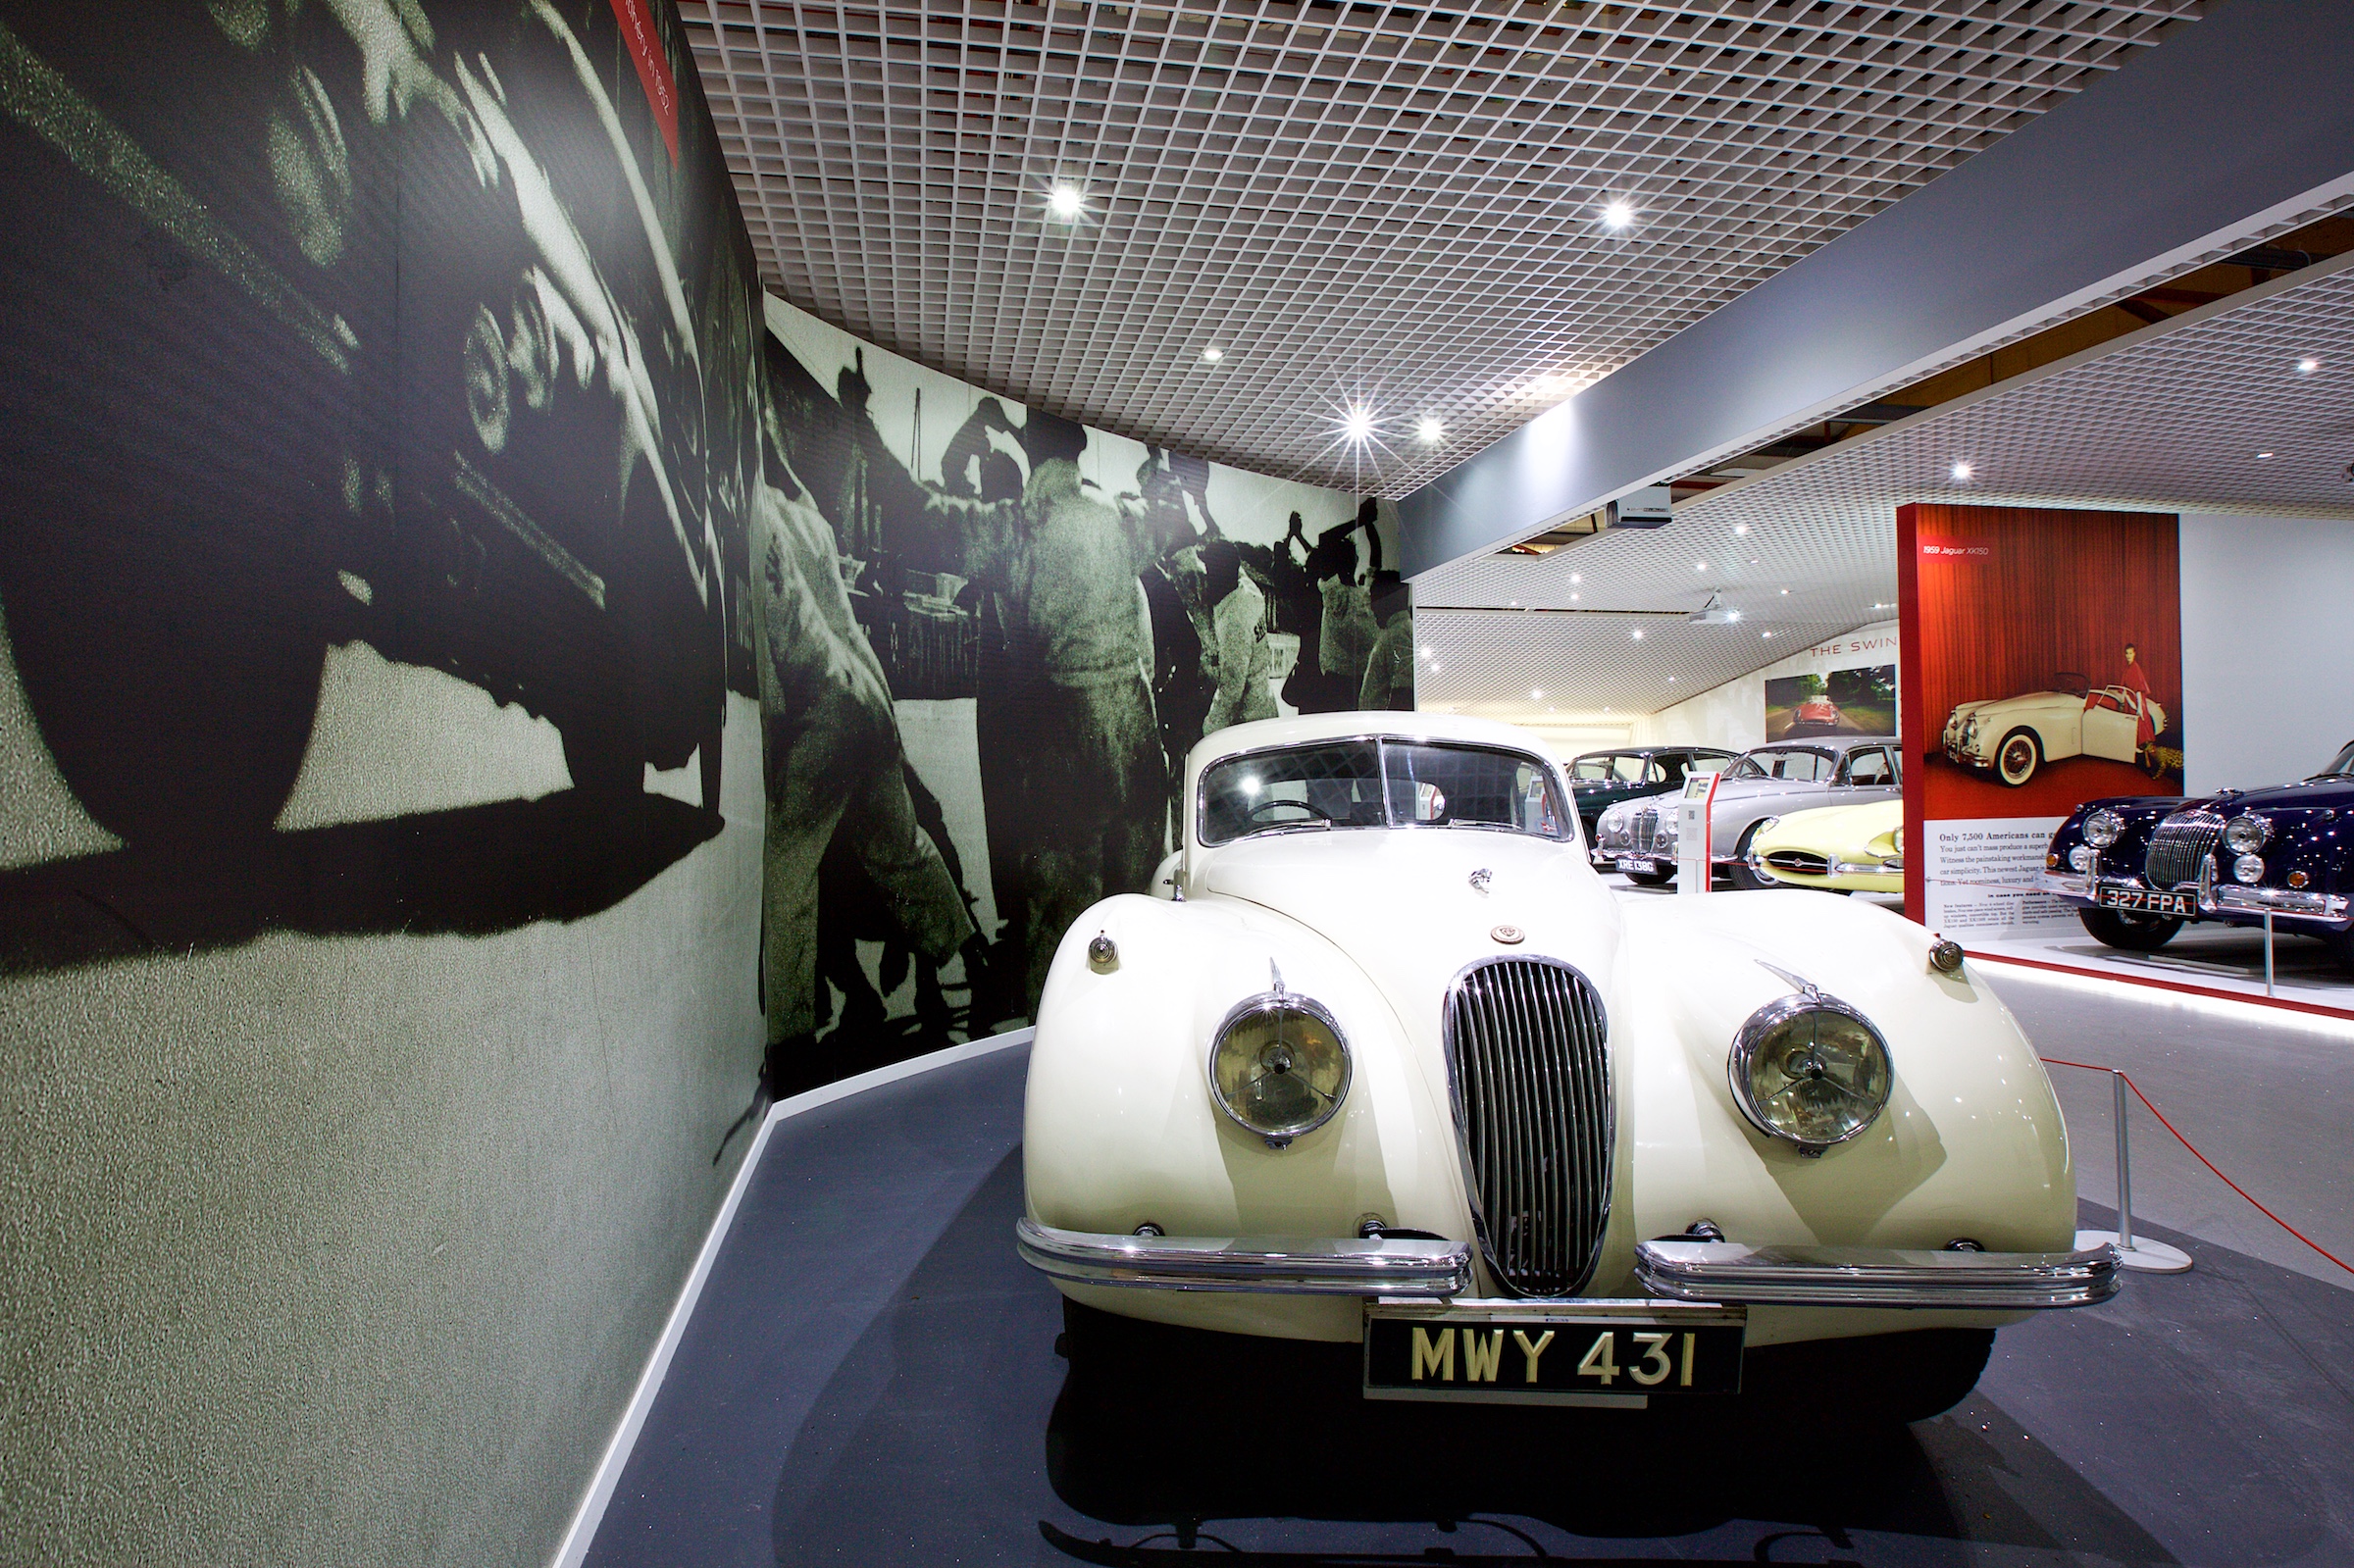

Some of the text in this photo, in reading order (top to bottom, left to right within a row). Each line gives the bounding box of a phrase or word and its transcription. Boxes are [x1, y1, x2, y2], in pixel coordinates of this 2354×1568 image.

[648, 50, 654, 76] in
[655, 69, 669, 116] 1952
[1923, 545, 1940, 554] 1959
[1940, 546, 1966, 556] Jaguar
[1810, 636, 1897, 657] THE SWIN
[1939, 834, 1959, 842] Only
[1962, 833, 1983, 841] 7,500
[1986, 832, 2028, 840] Americans
[1954, 844, 1966, 853] just
[1975, 854, 2011, 864] painstaking
[1618, 859, 1654, 872] XRE 138G
[1950, 867, 1982, 876] simplicity.
[2107, 889, 2186, 913] 327 FPA
[1411, 1327, 1696, 1387] MWY 431
